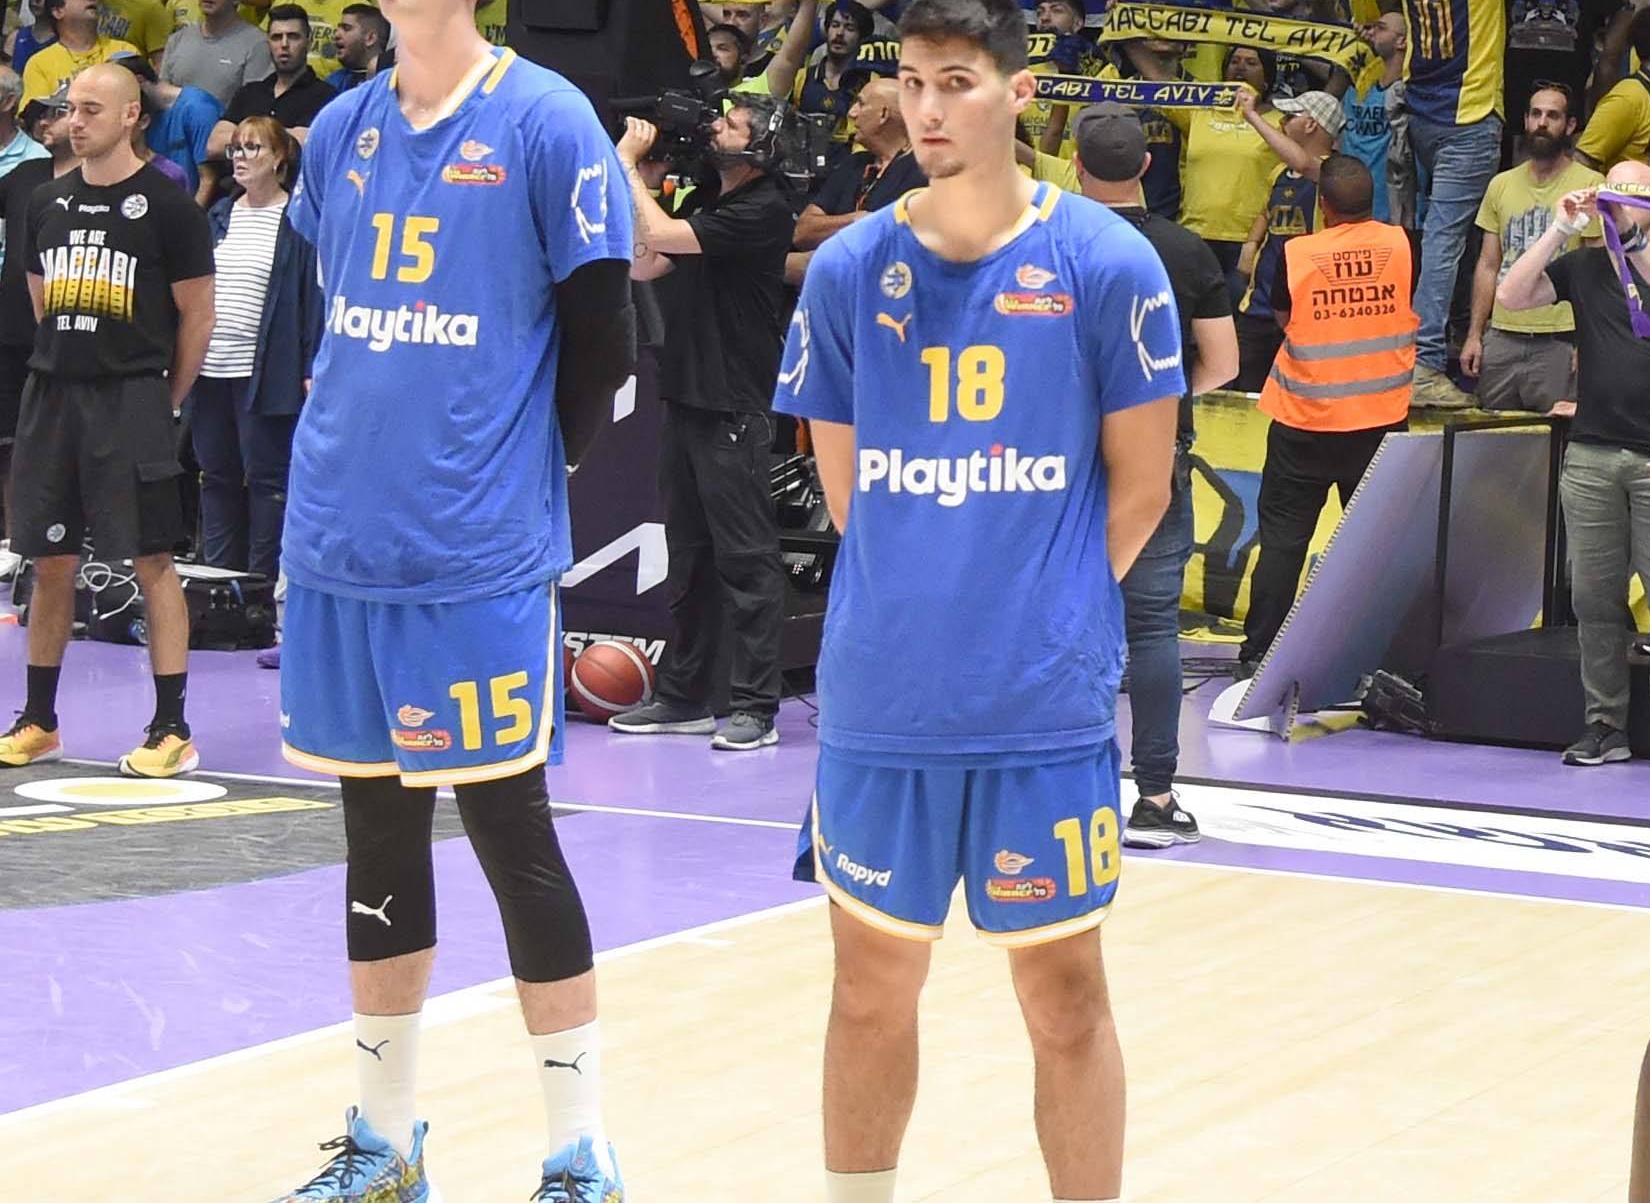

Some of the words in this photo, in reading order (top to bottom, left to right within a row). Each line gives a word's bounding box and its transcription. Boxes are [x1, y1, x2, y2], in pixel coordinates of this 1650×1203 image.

[1225, 17, 1276, 44] TEL
[1288, 27, 1361, 56] AVIV
[1036, 79, 1095, 98] CABI
[1102, 81, 1146, 101] TEL
[1153, 82, 1212, 102] AVIV
[69, 230, 87, 246] WE
[88, 230, 107, 246] ARE
[371, 212, 440, 284] 15
[1332, 249, 1372, 261] פירסט
[39, 246, 138, 324] MACCABI
[1334, 260, 1373, 277] עוז
[1312, 283, 1396, 307] אבטחה
[1313, 304, 1396, 321] 03-6240326
[57, 315, 72, 331] TEL
[75, 316, 98, 333] AVIV
[920, 344, 1006, 423] 18
[858, 444, 1067, 508] Playtika
[450, 671, 534, 751] 15
[1053, 805, 1121, 898] 18
[835, 852, 892, 888] Rapyd
